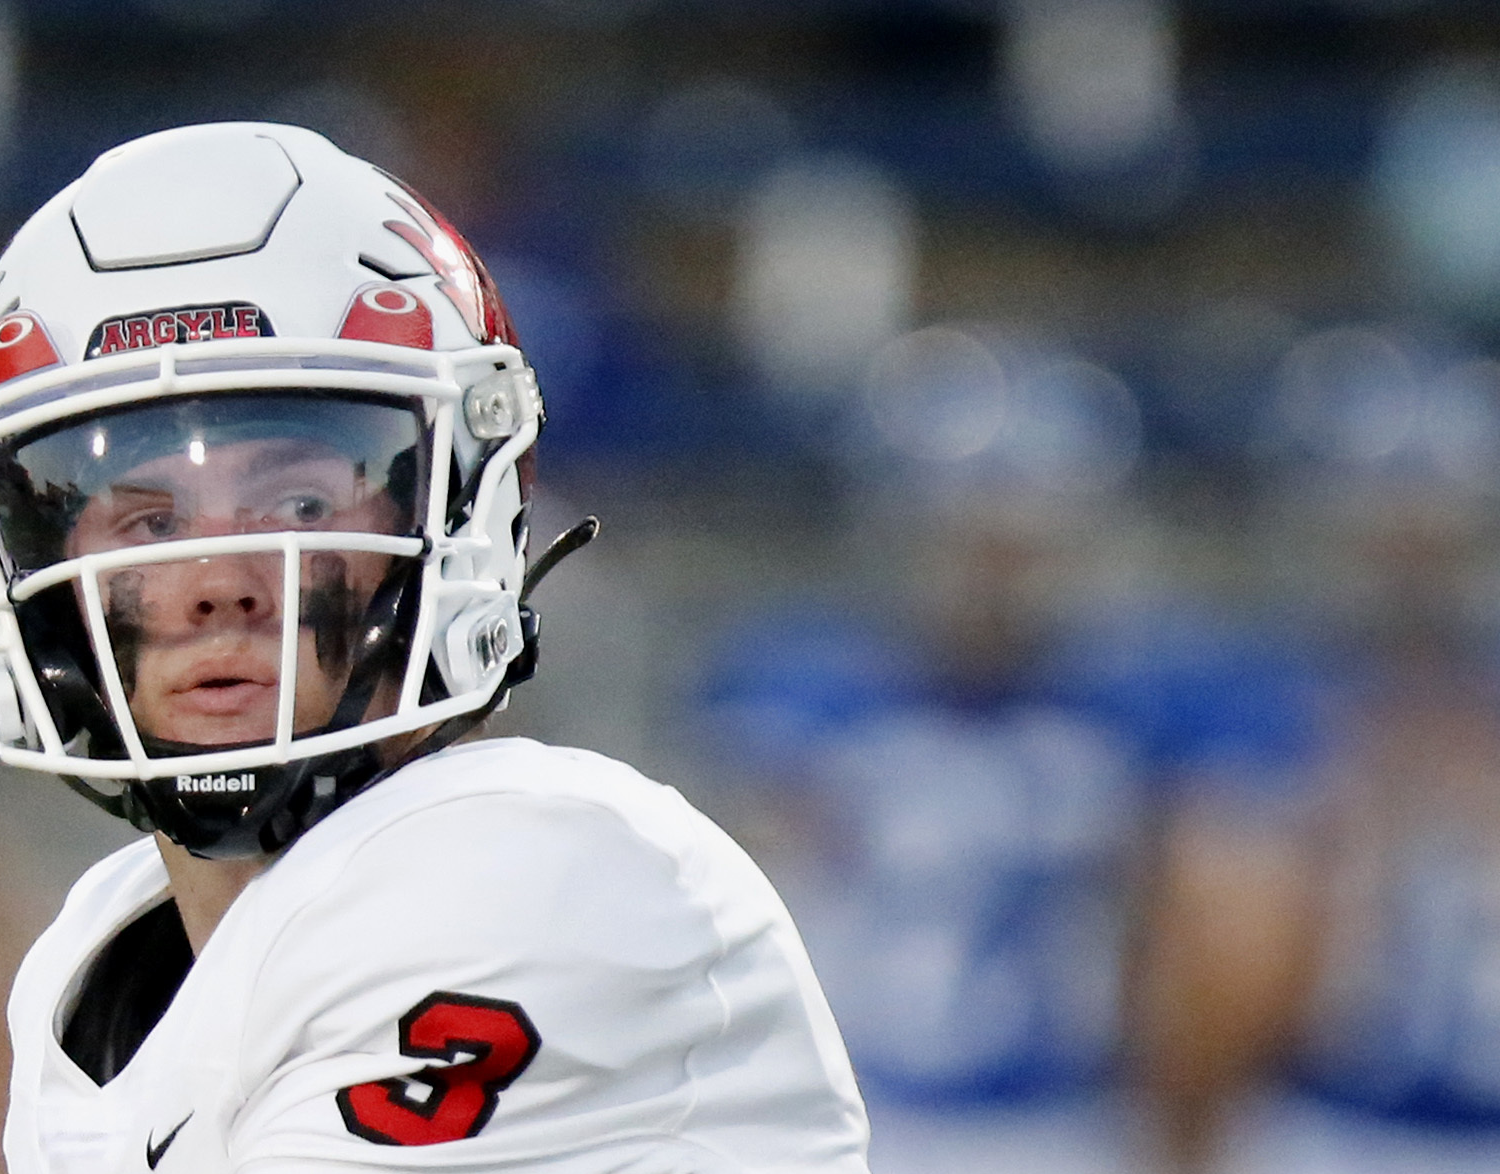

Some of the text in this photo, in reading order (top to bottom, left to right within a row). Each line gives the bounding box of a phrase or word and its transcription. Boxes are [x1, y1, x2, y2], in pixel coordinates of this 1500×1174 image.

[100, 307, 260, 355] ARGYLE
[176, 773, 256, 792] Riddell
[335, 989, 542, 1147] 3
